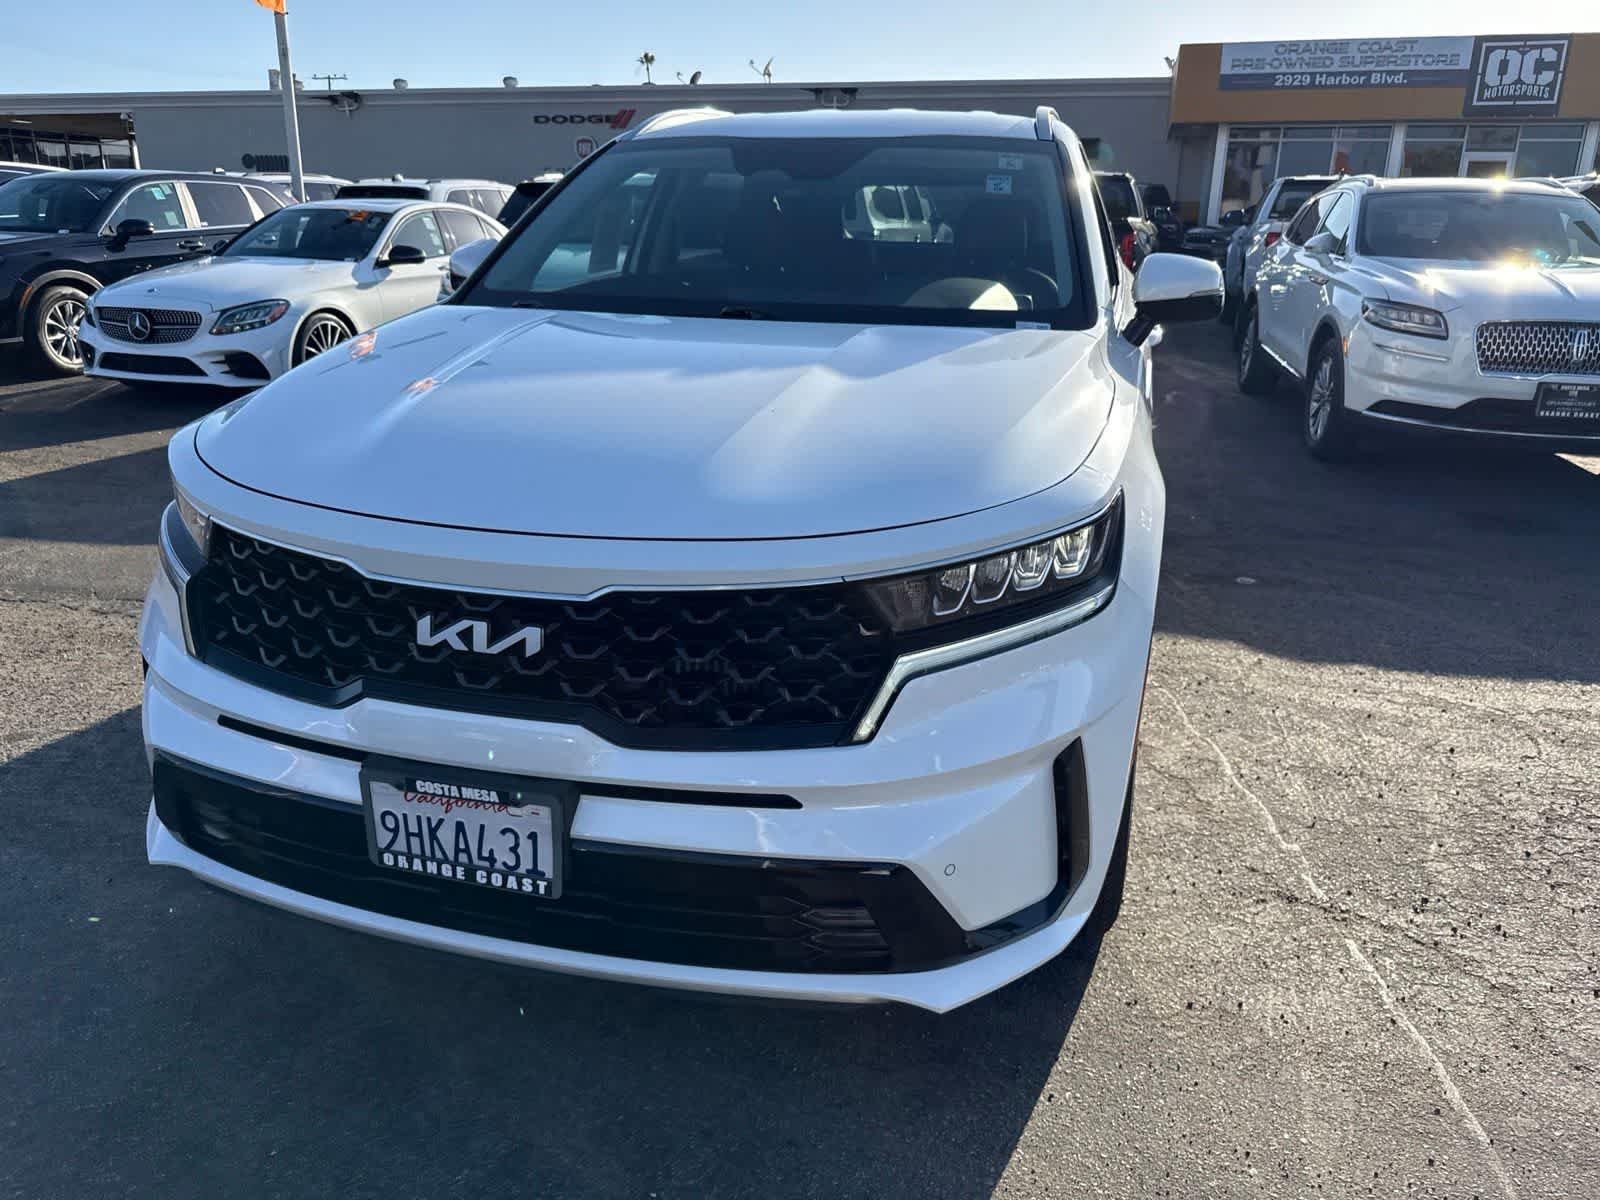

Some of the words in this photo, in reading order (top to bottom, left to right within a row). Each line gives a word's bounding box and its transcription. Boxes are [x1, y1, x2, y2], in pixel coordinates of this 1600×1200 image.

[1274, 41, 1350, 56] ORANGE
[1357, 39, 1418, 54] COAST
[1231, 55, 1334, 70] PRE-OWNED
[1338, 53, 1460, 69] SUPERSTORE
[1484, 47, 1558, 87] OC
[1274, 74, 1311, 86] 2929
[1314, 72, 1366, 86] Harbor
[1370, 72, 1408, 85] Blvd.
[1483, 84, 1550, 100] MOTORSPORTS
[533, 114, 616, 125] DODGE
[416, 615, 541, 658] KIA
[415, 779, 459, 798] COSTA
[461, 786, 500, 803] MESA
[380, 810, 546, 878] 9HKA431
[383, 852, 466, 881] ORANGE
[476, 869, 548, 896] COAST
